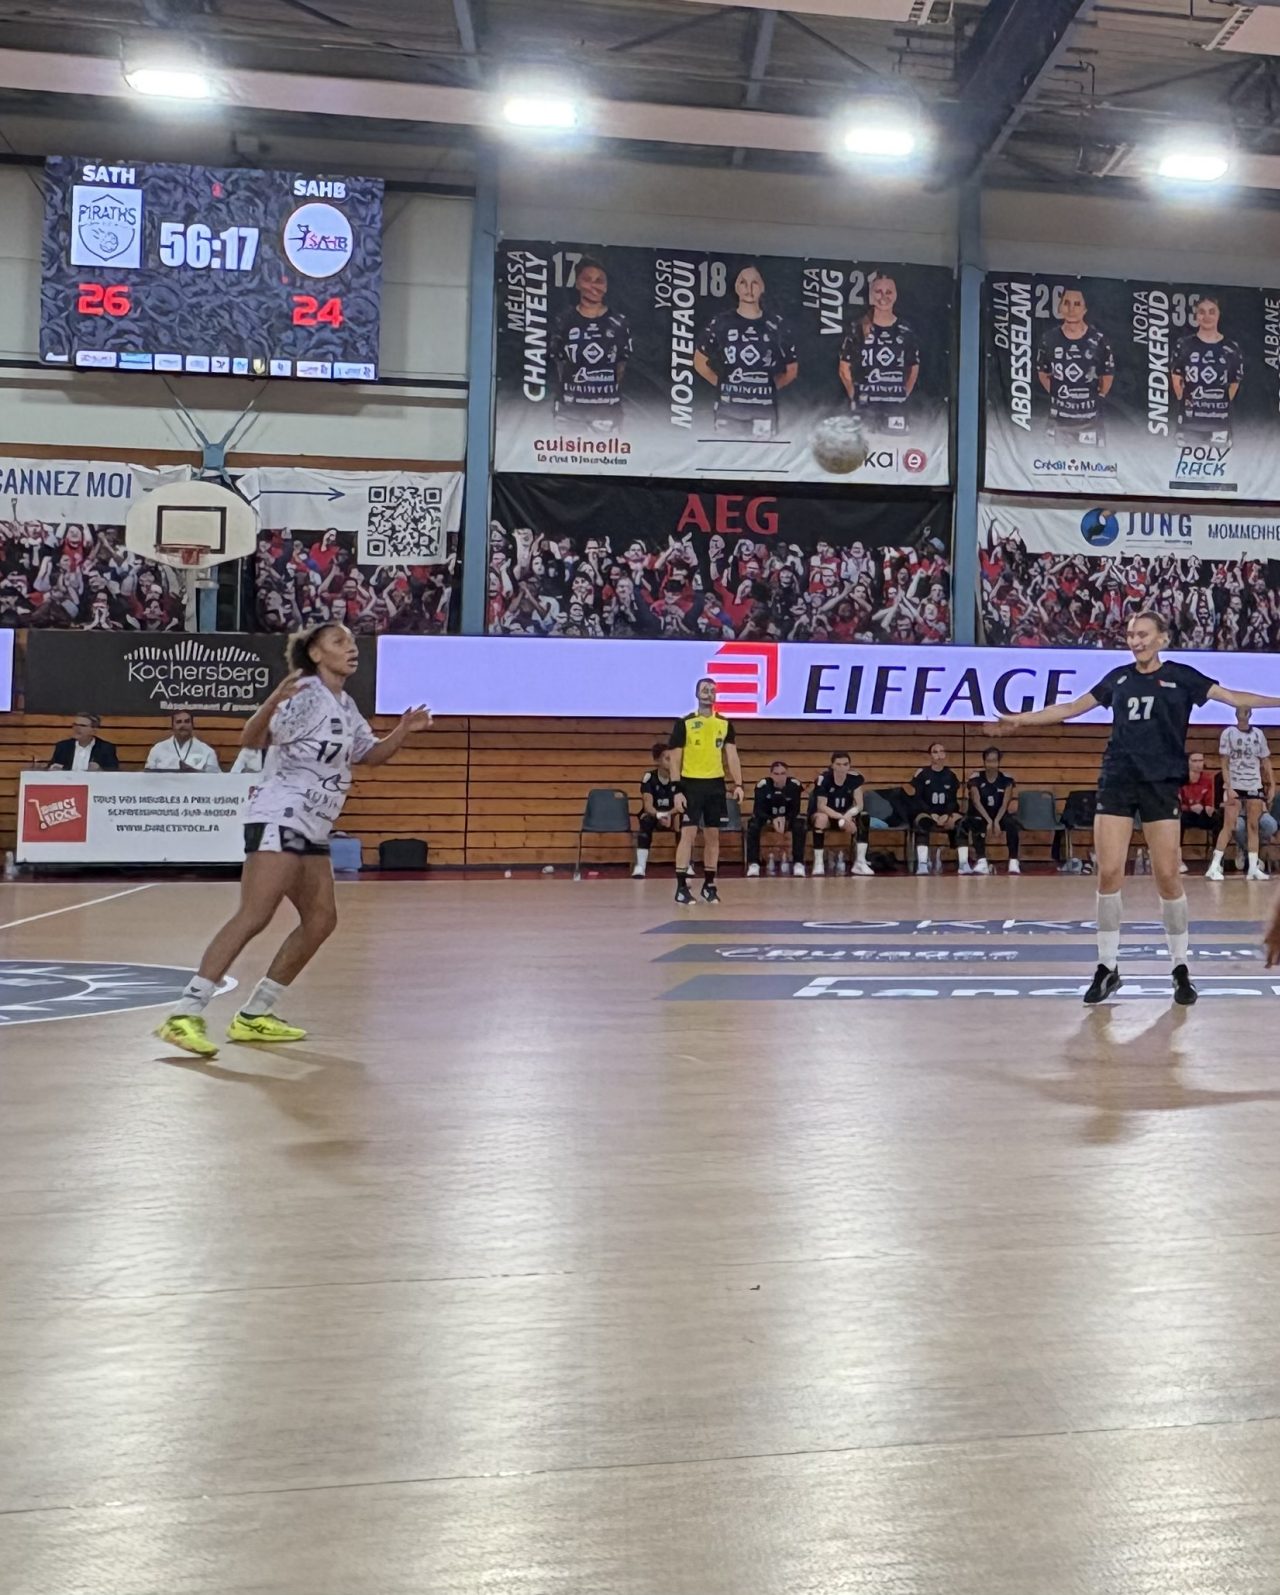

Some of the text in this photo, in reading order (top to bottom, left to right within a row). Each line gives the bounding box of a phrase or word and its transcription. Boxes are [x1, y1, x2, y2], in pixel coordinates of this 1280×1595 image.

[82, 165, 136, 185] SATH
[293, 180, 347, 199] SAHB
[78, 204, 136, 225] PIRATHS
[159, 222, 260, 271] 56:17
[552, 251, 583, 288] 17
[655, 259, 672, 309] YOSR
[698, 261, 727, 297] 18
[78, 283, 131, 316] 26
[504, 251, 525, 332] MÉLISSA
[803, 268, 820, 308] LISA
[820, 269, 844, 335] VLUG
[292, 296, 343, 328] 24
[523, 252, 548, 402] CHANTELLY
[992, 282, 1010, 349] DALILA
[1132, 290, 1149, 344] NORA
[670, 260, 696, 429] MOSTEFAOUI
[1264, 298, 1279, 370] ALBANE
[1010, 282, 1032, 432] ABDESSELAM
[1148, 291, 1169, 437] SNEDKERUD
[534, 436, 631, 455] cuisinella
[1182, 447, 1231, 461] POLY
[0, 468, 132, 498] ANNEZ MOI
[1176, 461, 1226, 478] RACK
[677, 493, 779, 535] AEG
[1126, 512, 1192, 537] JUNG
[128, 661, 269, 687] Kochersberg
[150, 681, 254, 699] Ackerland
[804, 664, 1077, 717] EIFFAGE
[1127, 696, 1155, 721] 27
[317, 741, 343, 764] 17
